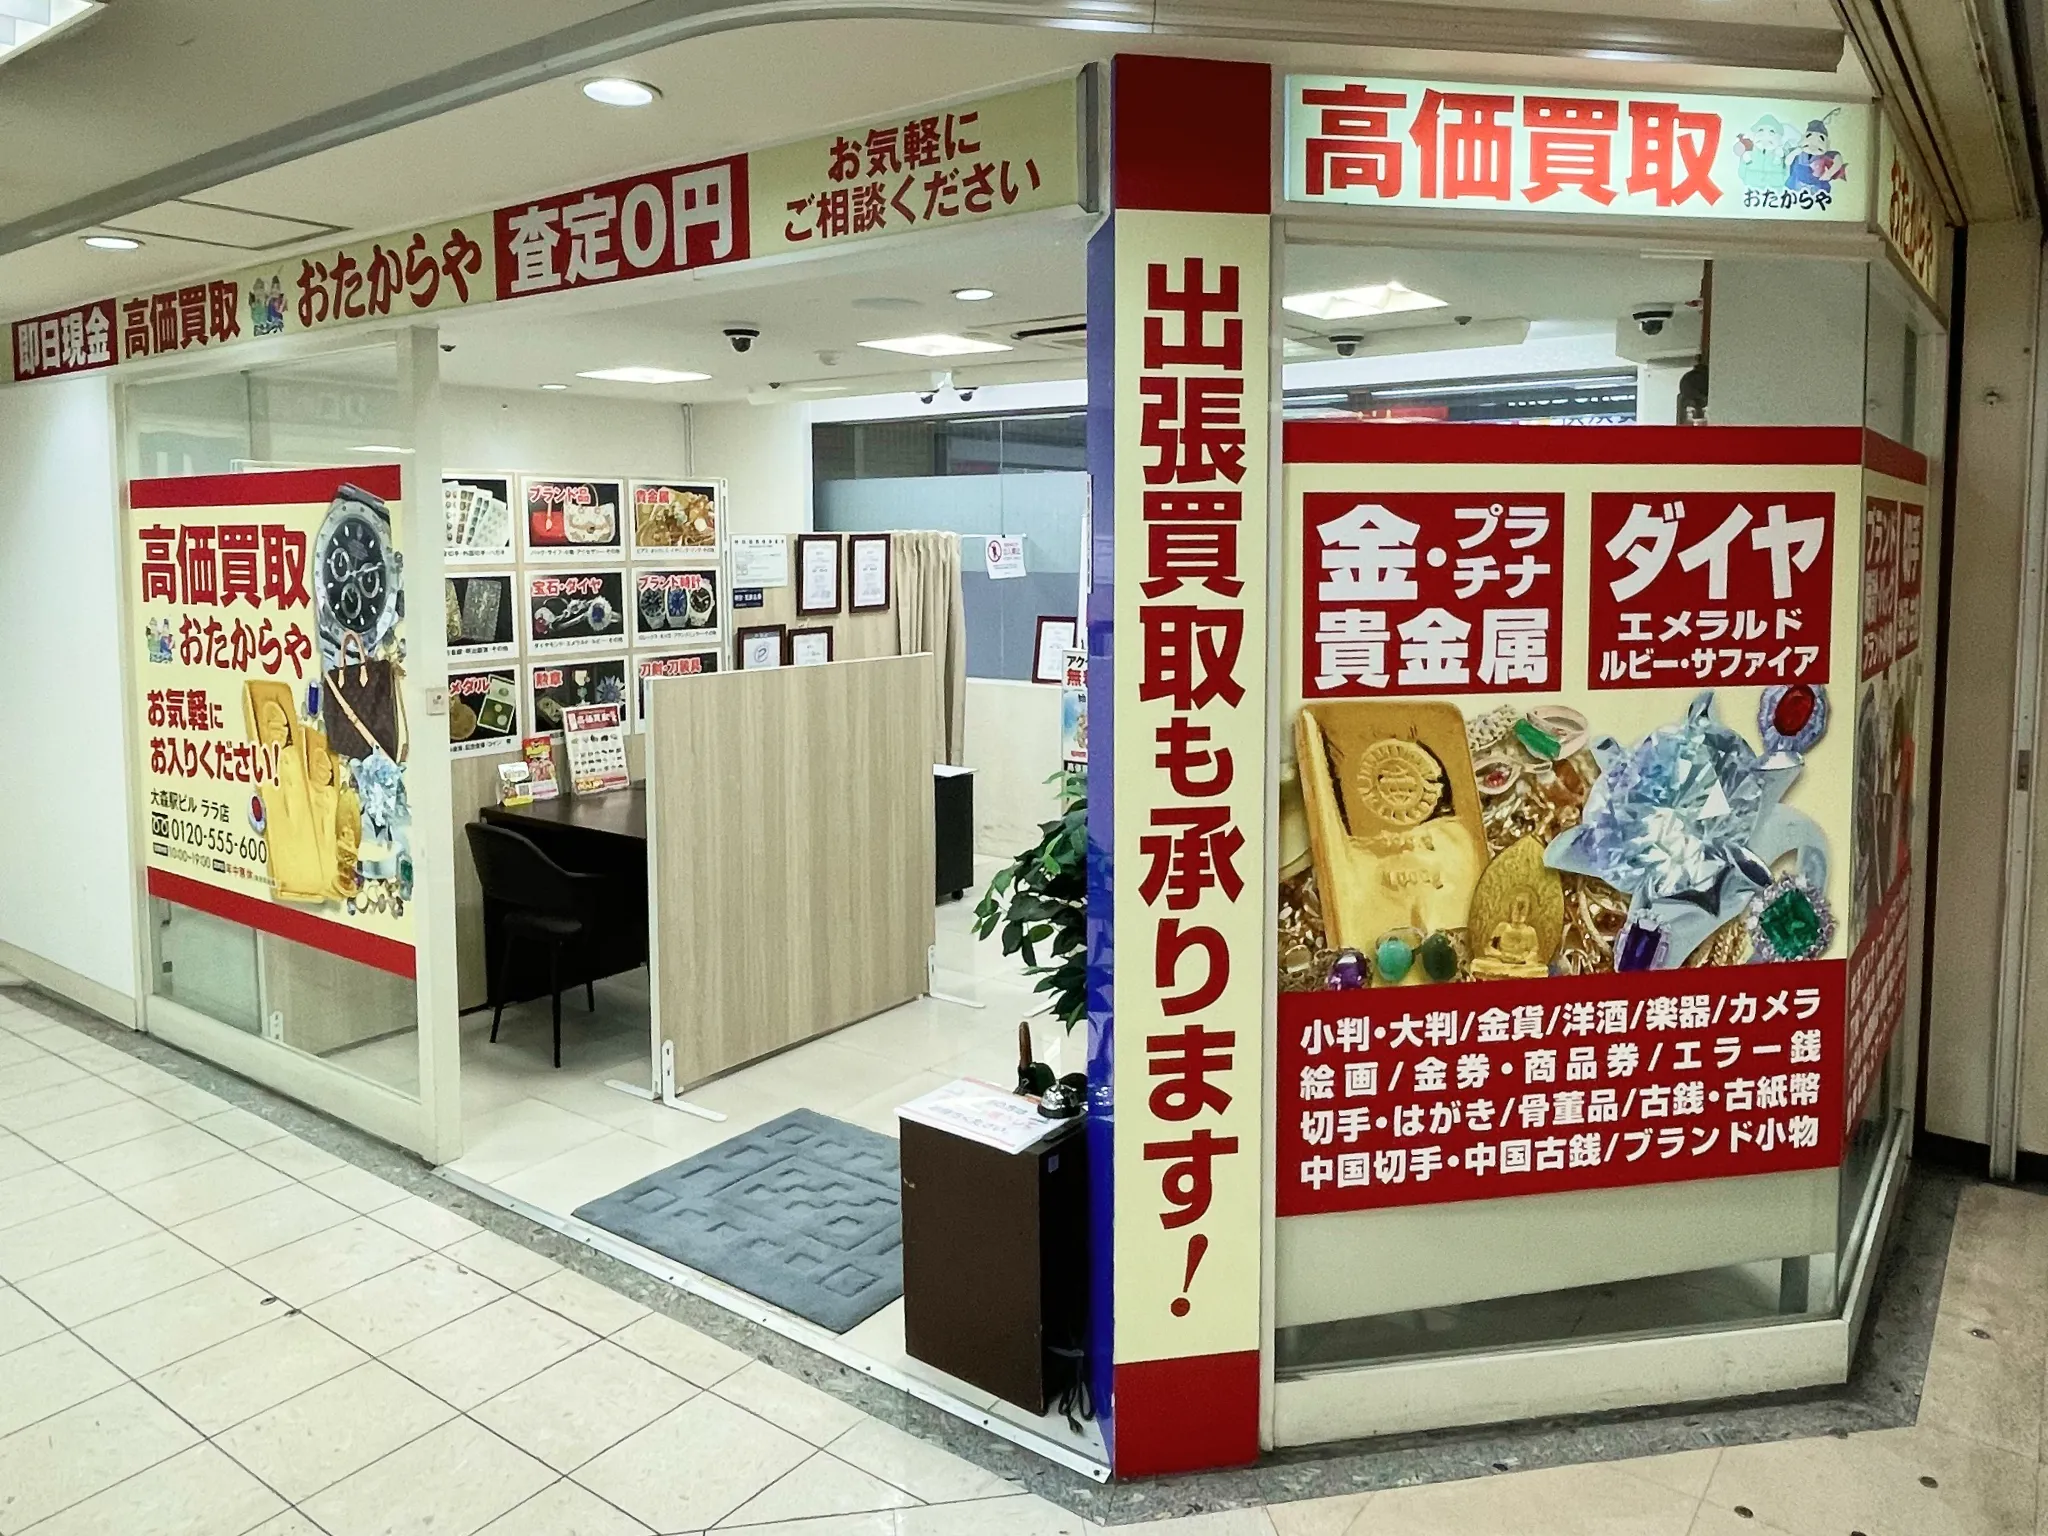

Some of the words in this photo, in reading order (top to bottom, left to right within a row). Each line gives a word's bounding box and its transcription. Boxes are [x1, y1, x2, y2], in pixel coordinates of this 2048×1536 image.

[829, 111, 980, 181] お気軽に
[1302, 84, 1724, 207] 高価買取
[784, 158, 1040, 243] ご相談ください
[1744, 188, 1832, 211] おたからや
[509, 165, 733, 293] 査定0円
[297, 228, 482, 328] おたからや
[19, 303, 110, 375] 即日現金
[123, 280, 241, 359] 高価買取
[530, 486, 590, 504] ブランド品
[635, 489, 670, 504] 貴金属
[139, 524, 310, 610] 高価買取
[1605, 502, 1825, 602] ダイヤ
[532, 578, 602, 596] 宝石・ダイヤ
[179, 614, 311, 679] おたからや
[1315, 607, 1549, 690] 貴金属
[1617, 608, 1803, 642] エメラルド
[449, 677, 490, 697] メダル
[1067, 655, 1088, 668] アク
[1600, 646, 1819, 681] ルビー・サファイア
[148, 689, 223, 731] お気軽に
[151, 737, 280, 787] お入りください!
[151, 788, 197, 812] 大森駅ビル
[201, 800, 229, 823] ララ店
